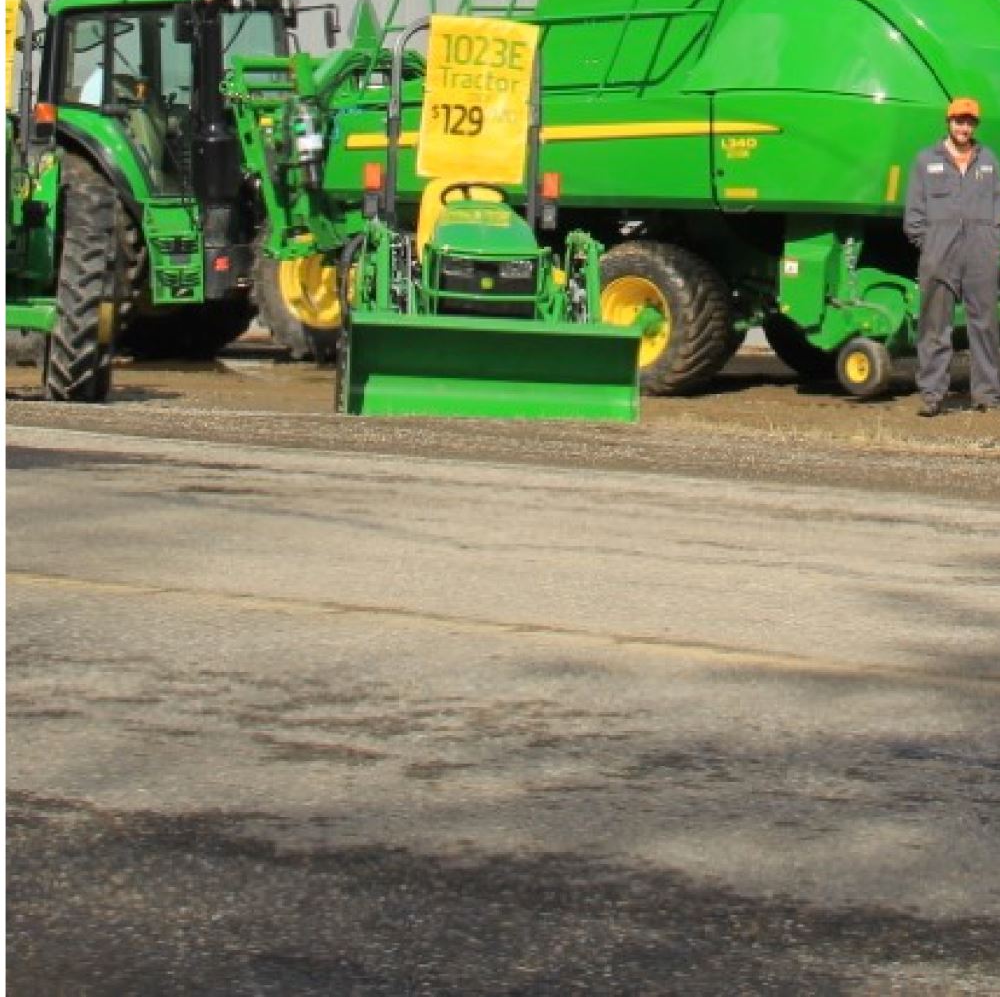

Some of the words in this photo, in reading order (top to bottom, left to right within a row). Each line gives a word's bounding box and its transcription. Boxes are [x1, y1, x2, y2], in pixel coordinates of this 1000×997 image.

[440, 33, 529, 70] 1023E
[438, 65, 521, 93] Tractor
[431, 103, 484, 136] $129
